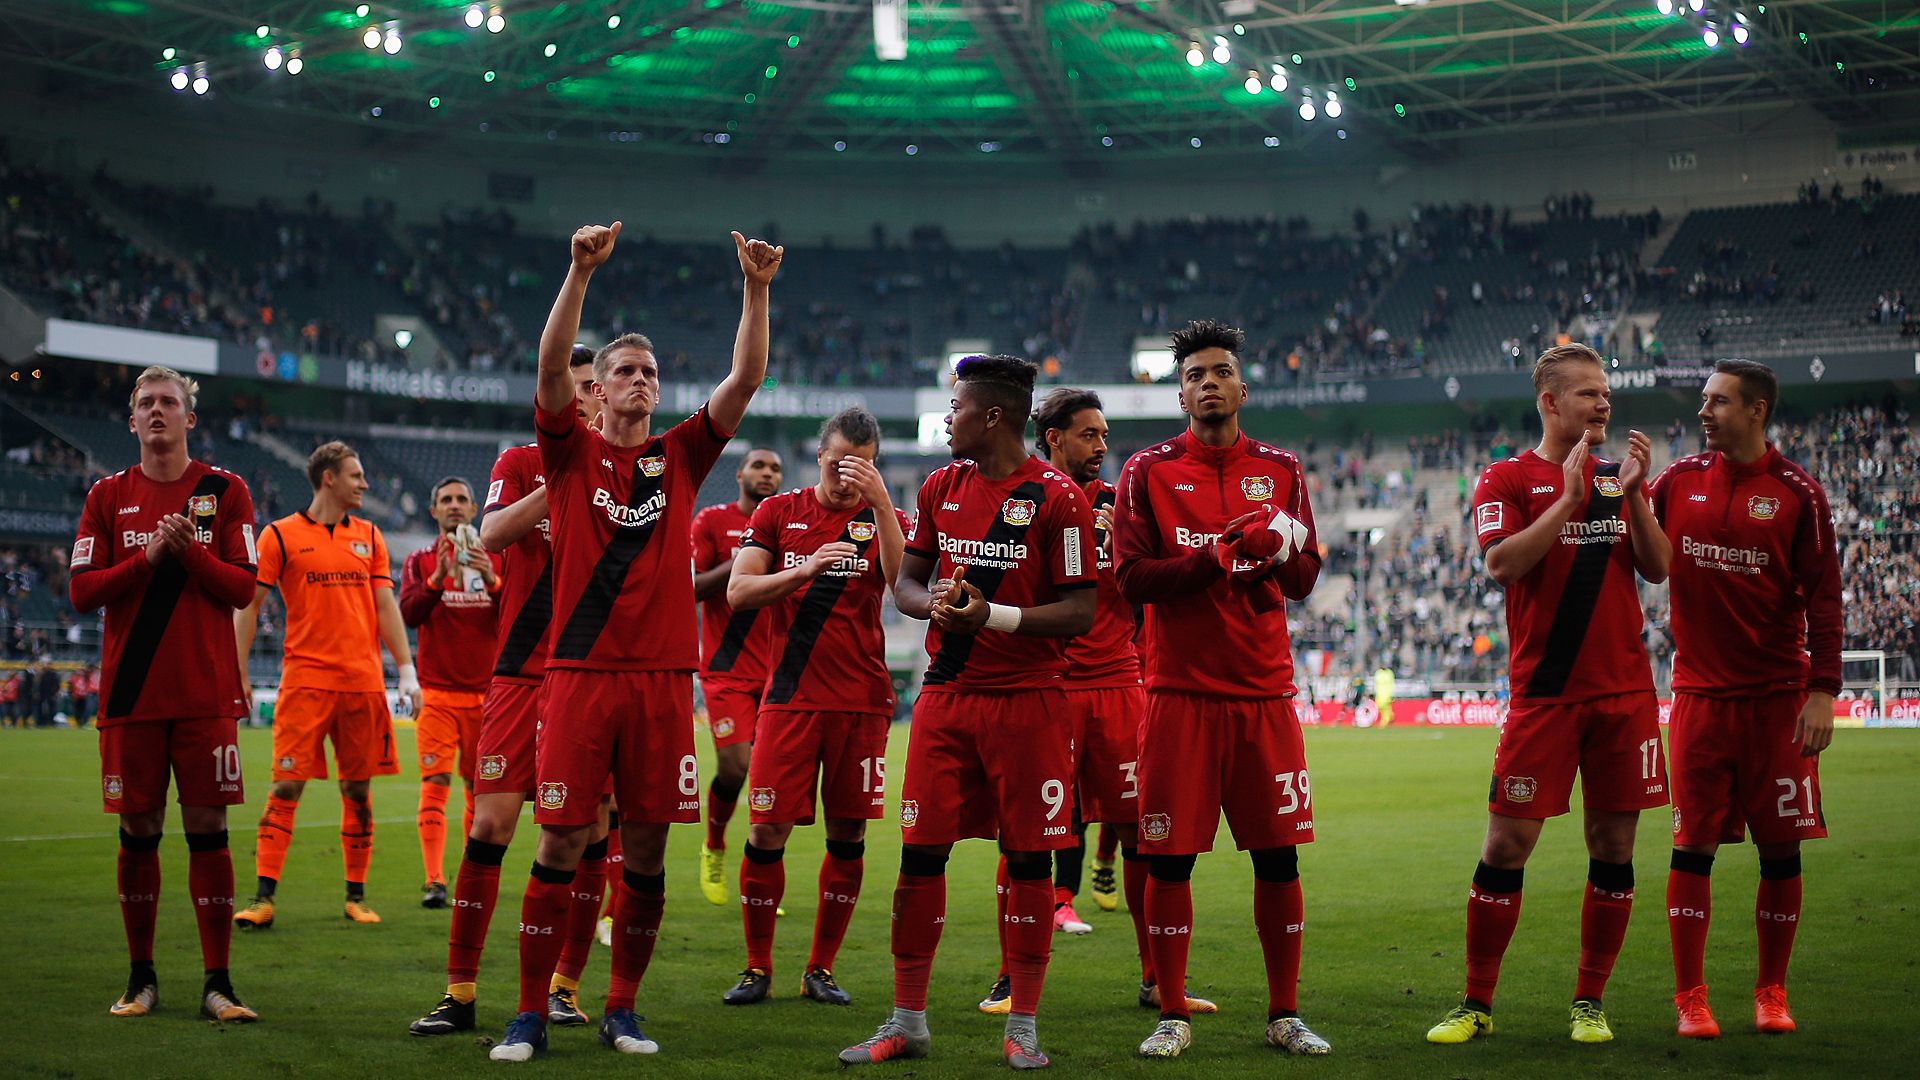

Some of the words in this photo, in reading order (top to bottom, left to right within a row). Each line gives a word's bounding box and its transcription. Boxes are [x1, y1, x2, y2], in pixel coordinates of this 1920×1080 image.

[346, 359, 508, 402] H-Hotels.com
[1606, 370, 1656, 390] orus
[1174, 483, 1194, 492] JAKO
[1531, 485, 1554, 494] JAKO
[1689, 494, 1707, 502] JAKO
[786, 522, 808, 530] JAKO
[1559, 515, 1627, 536] rmenia
[938, 532, 1027, 559] Barmenia
[1682, 536, 1769, 566] Barmenia
[950, 553, 1018, 570] Versicherungen
[1695, 557, 1761, 575] Versicherungen
[306, 569, 368, 584] Barmenia
[212, 744, 241, 782] 10
[1640, 737, 1658, 779] 17
[678, 755, 698, 796] 8
[1275, 769, 1312, 815] 39
[1645, 785, 1663, 795] JAKO
[1776, 776, 1814, 817] 21
[678, 801, 699, 810] JAKO
[1041, 779, 1064, 821] 9
[1043, 826, 1067, 836] JAKO
[1295, 820, 1312, 831] JAKO
[1795, 818, 1816, 827] JAKO
